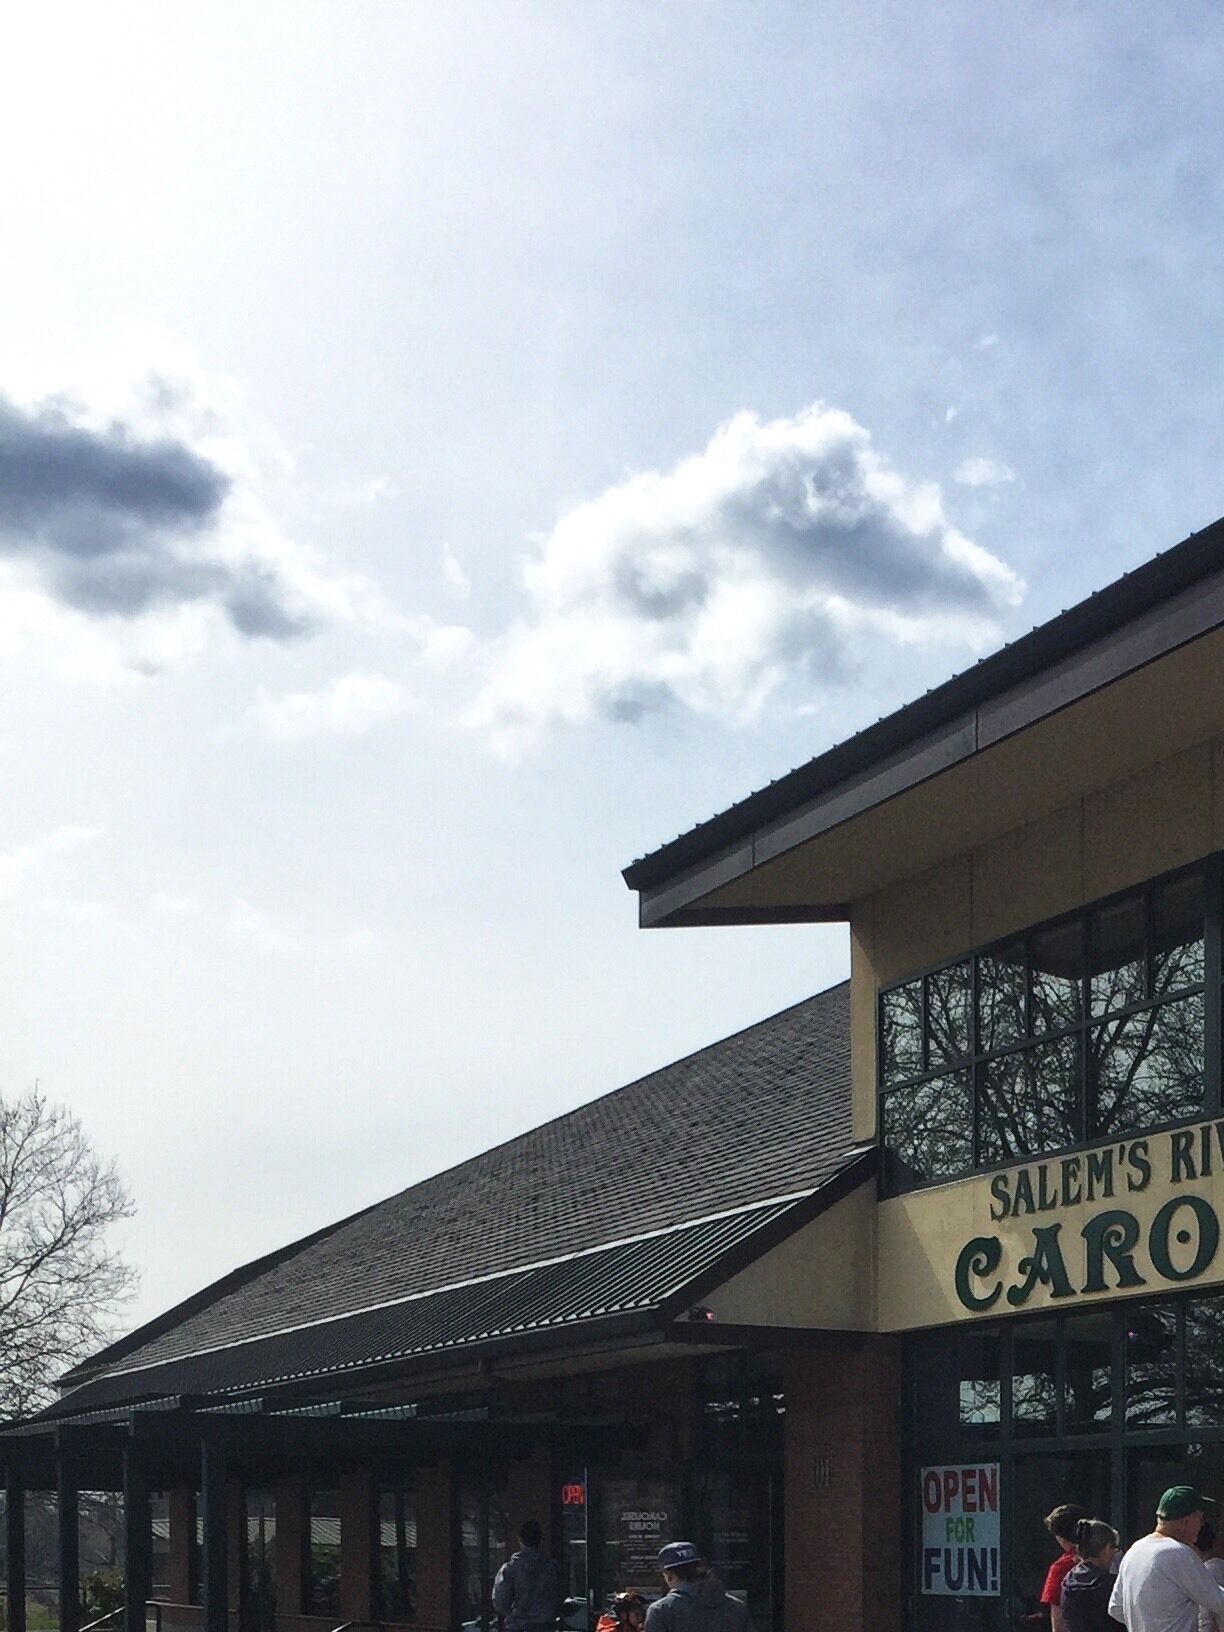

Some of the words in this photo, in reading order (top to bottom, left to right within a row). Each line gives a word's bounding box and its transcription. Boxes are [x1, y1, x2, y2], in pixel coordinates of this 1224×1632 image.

[989, 1140, 1150, 1221] SALEM'S
[561, 1484, 584, 1504] OPEN
[924, 1469, 997, 1513] OPEN
[946, 1517, 975, 1543] FOR
[925, 1548, 998, 1592] FUN!
